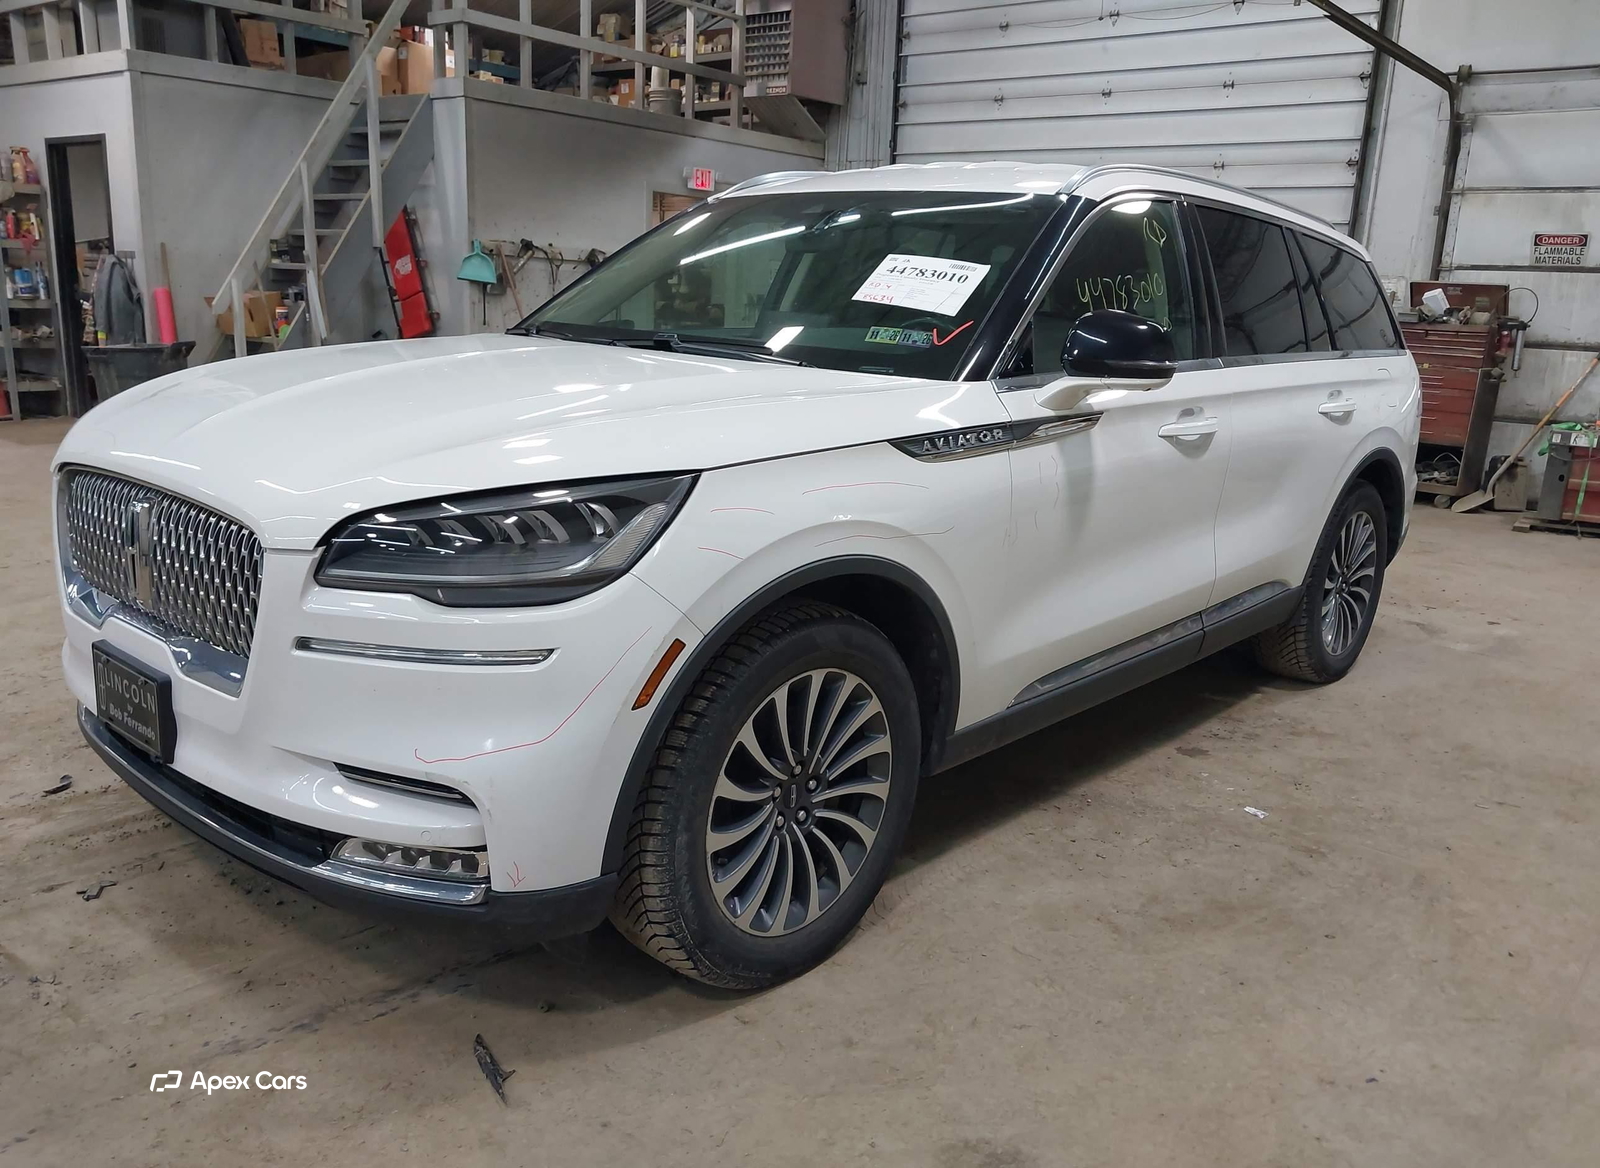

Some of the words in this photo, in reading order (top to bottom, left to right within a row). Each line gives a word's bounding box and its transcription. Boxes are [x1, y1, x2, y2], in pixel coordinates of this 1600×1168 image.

[695, 168, 712, 188] EXIT
[1541, 236, 1580, 244] DANGER
[1533, 246, 1586, 256] FLAMMABLE
[1534, 256, 1582, 265] MATERIALS
[886, 265, 969, 283] 44783010
[1076, 272, 1164, 312] 44783010
[921, 428, 1004, 453] AVIATOR
[105, 668, 155, 713] LINCOLN
[110, 703, 122, 720] Bob
[124, 712, 156, 740] Ferrando
